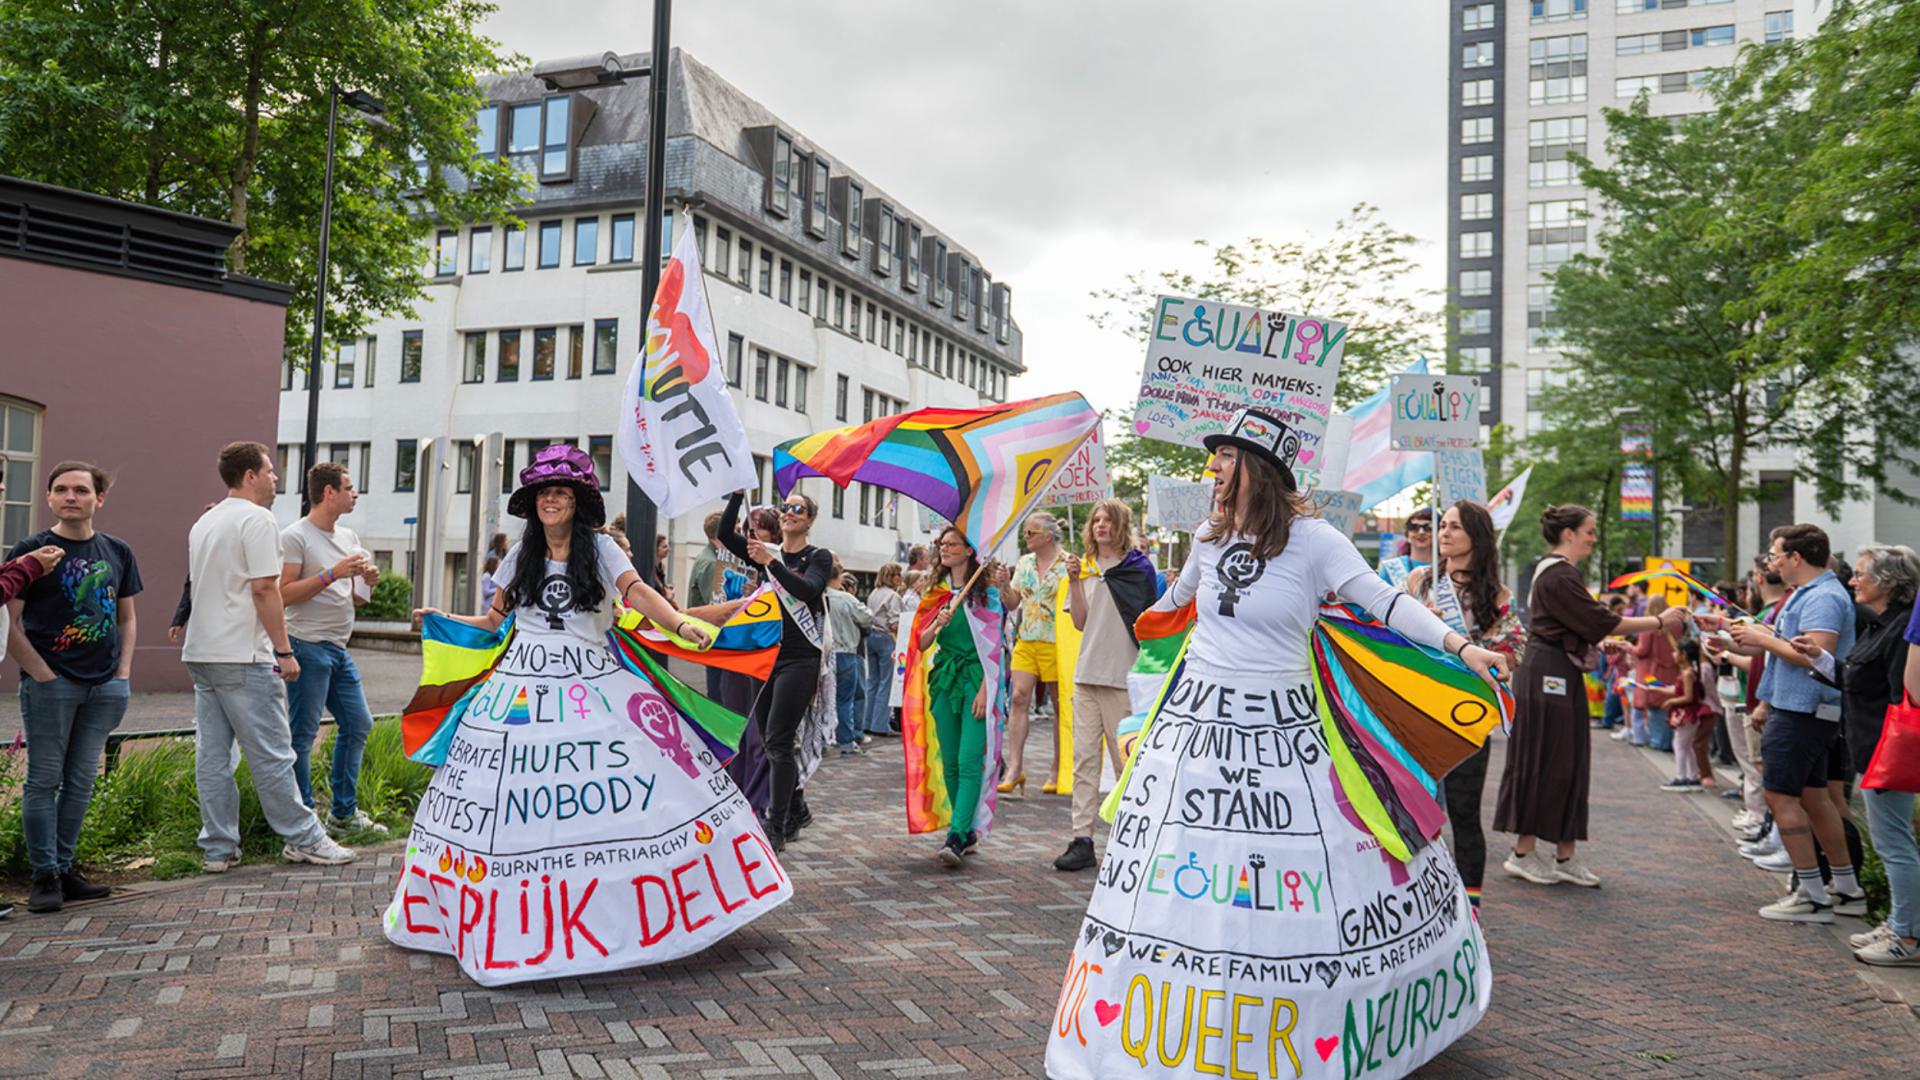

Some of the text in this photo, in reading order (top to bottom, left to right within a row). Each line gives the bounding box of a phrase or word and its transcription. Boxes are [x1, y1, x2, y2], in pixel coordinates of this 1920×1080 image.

[1140, 384, 1175, 401] DOLLE
[1158, 356, 1192, 375] OOK
[1202, 365, 1242, 383] HIER
[1252, 372, 1322, 397] NAMENS:
[1252, 388, 1286, 403] ODET
[1147, 410, 1176, 428] LOES
[1170, 678, 1236, 719] OVE
[448, 735, 502, 770] EBRATE
[510, 740, 630, 775] HURTS
[1189, 724, 1293, 768] UNITED
[1219, 766, 1261, 788] WE
[505, 773, 656, 826] NOBODY
[1181, 788, 1292, 830] STAND
[584, 831, 689, 868] PATRIARCHY
[1340, 890, 1402, 947] GAYS
[1128, 940, 1167, 962] WE
[1171, 951, 1221, 976] ARE
[1229, 958, 1313, 983] FAMILY
[1344, 956, 1376, 978] WE
[1380, 944, 1407, 972] ARE
[1121, 973, 1303, 1080] QUEER
